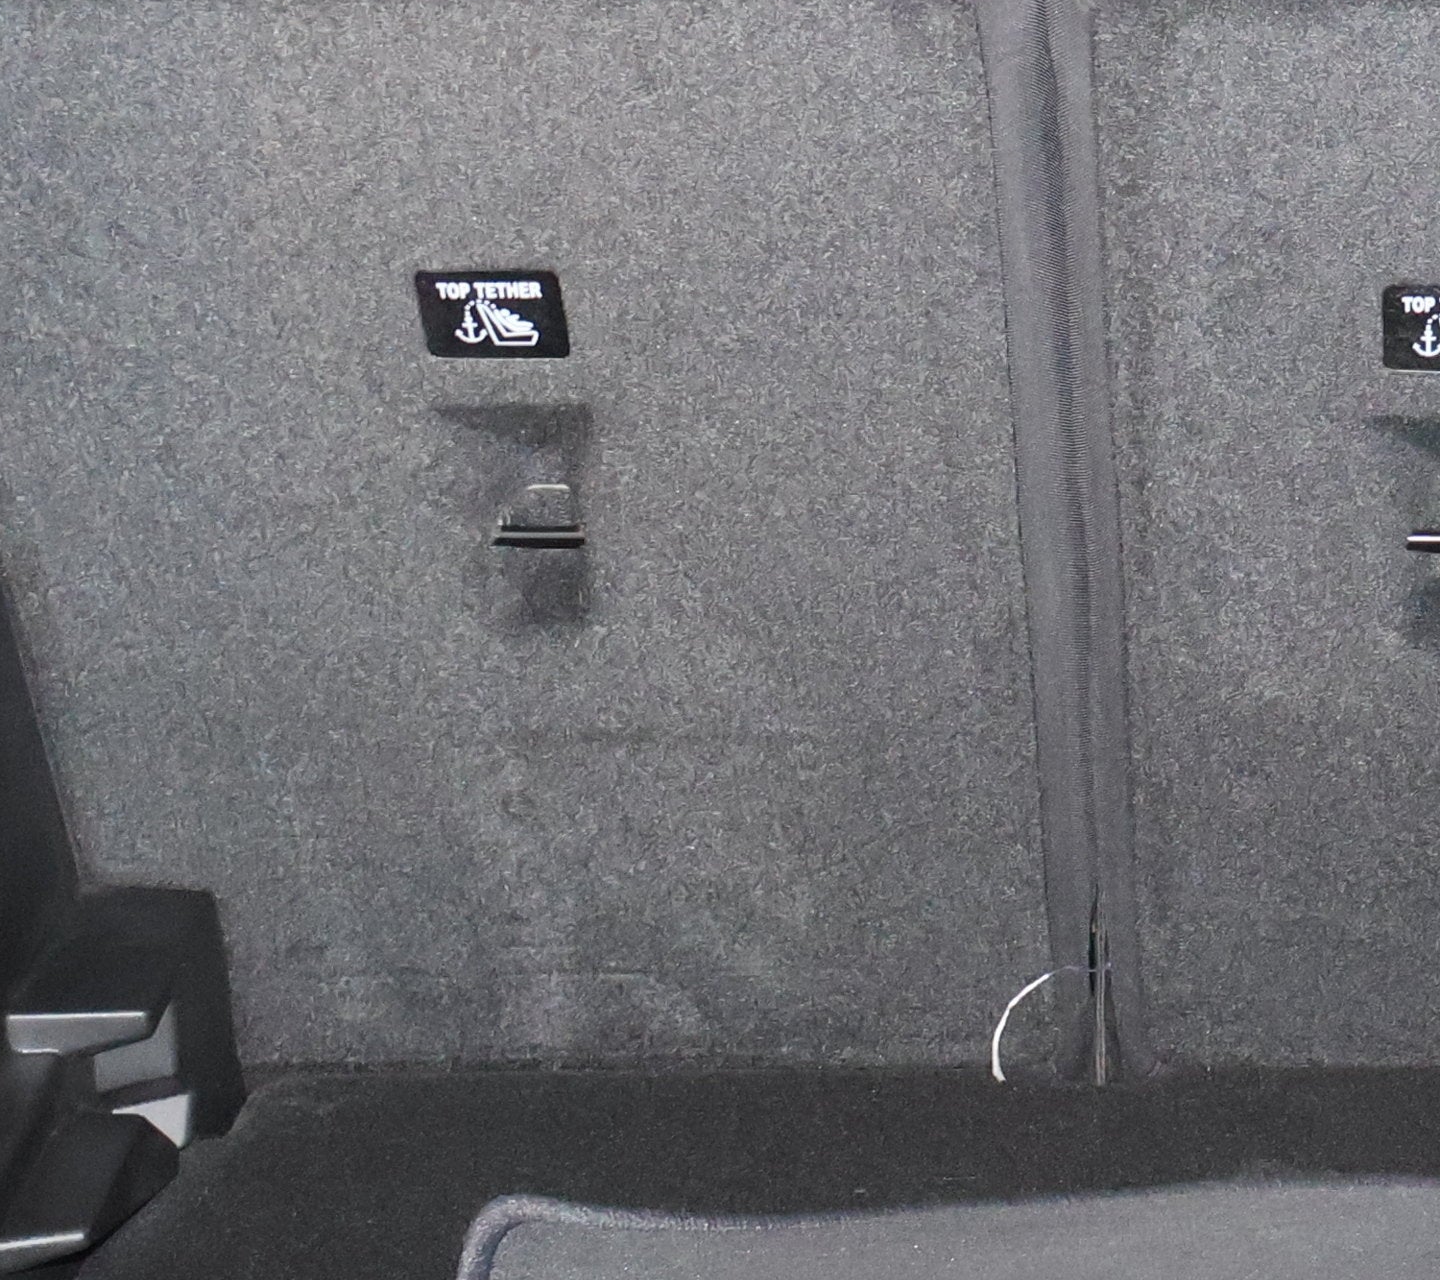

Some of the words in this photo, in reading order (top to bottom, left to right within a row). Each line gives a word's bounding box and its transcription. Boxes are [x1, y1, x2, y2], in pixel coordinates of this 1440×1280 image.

[435, 282, 471, 299] TOP
[473, 281, 543, 299] TETHER
[1401, 296, 1436, 313] TOP
